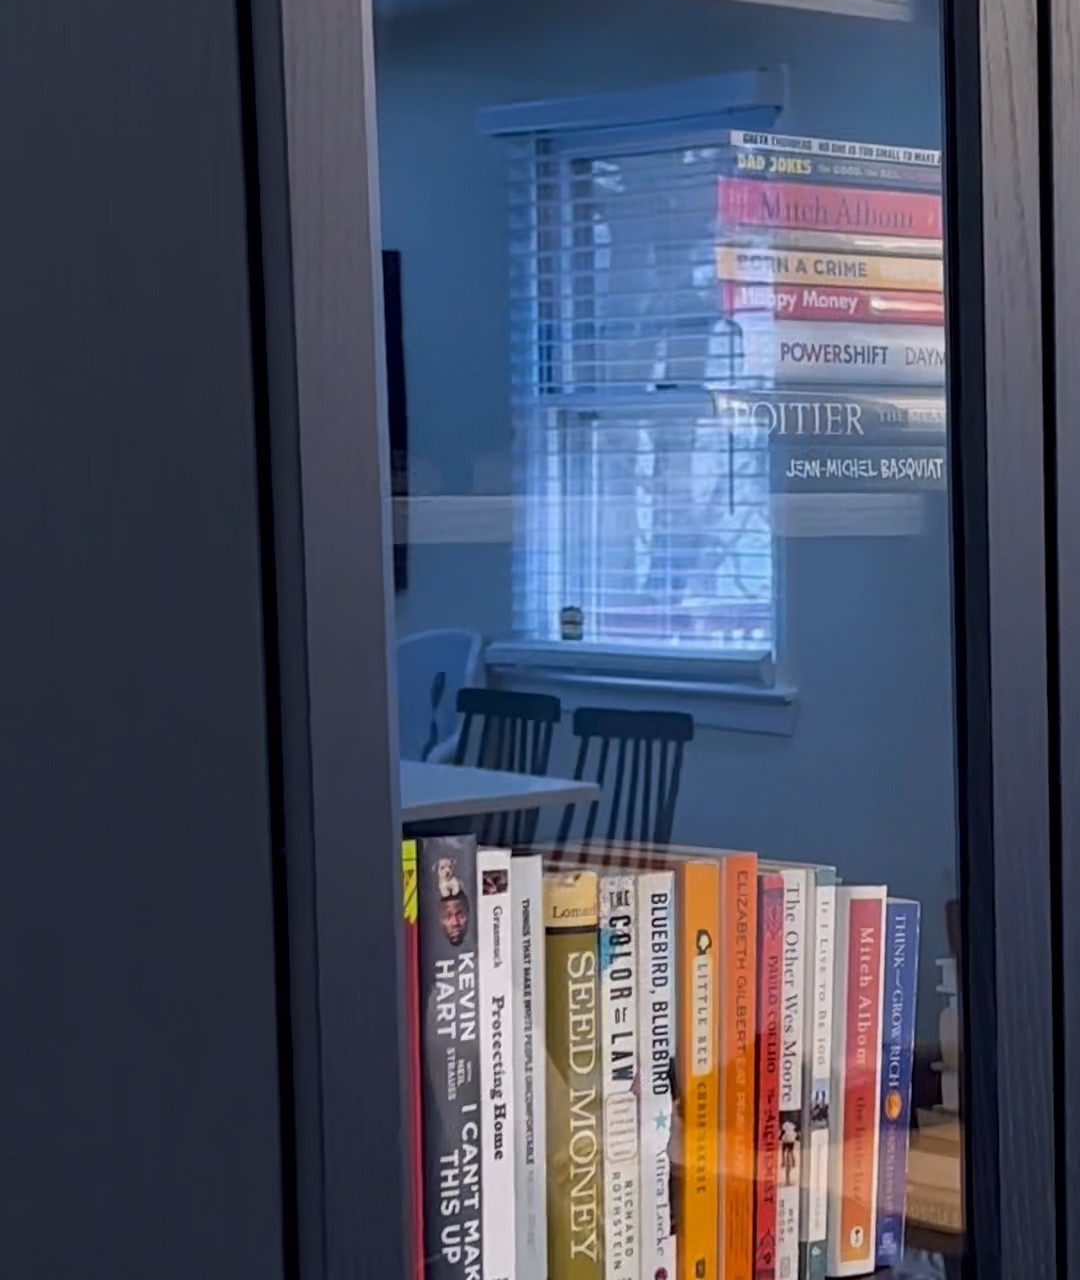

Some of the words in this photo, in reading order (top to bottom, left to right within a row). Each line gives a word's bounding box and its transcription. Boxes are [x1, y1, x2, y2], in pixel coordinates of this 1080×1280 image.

[737, 152, 766, 171] DAD
[768, 155, 812, 175] JOKES
[760, 191, 828, 226] Mitch
[836, 194, 914, 229] Albom
[795, 260, 808, 275] A
[813, 259, 868, 278] CRIME
[803, 290, 859, 314] Money
[780, 342, 889, 366] POWERSHIFT
[733, 400, 865, 437] POITIER
[785, 458, 878, 479] JEAN-MICHEL
[880, 458, 944, 481] BASQUIAT
[608, 890, 630, 908] THE
[735, 870, 749, 968] ELIZABETH
[785, 881, 801, 923] The
[608, 914, 633, 1002] COLOR
[649, 892, 669, 995] BLUEBIRD,
[783, 928, 800, 988] Other
[859, 925, 875, 989] Mitch
[893, 915, 907, 969] THINK
[434, 959, 458, 1041] HART
[457, 951, 477, 1042] KEVIN
[566, 950, 596, 1075] SEED
[696, 962, 708, 1026] LITTLE
[735, 976, 749, 1053] GILBERT
[783, 992, 799, 1033] Wes
[890, 988, 905, 1041] GROW
[490, 995, 508, 1101] Protecting
[610, 1031, 635, 1082] LAW
[651, 1001, 671, 1096] BLUEBIRD
[855, 995, 873, 1067] Albom
[781, 1037, 798, 1104] Moore
[887, 1043, 901, 1088] RICH
[461, 1103, 478, 1114] I
[493, 1103, 508, 1162] Home
[439, 1149, 461, 1218] THIS
[461, 1121, 481, 1211] CAN'T
[569, 1086, 598, 1264] MONEY
[440, 1224, 462, 1265] UP
[611, 1171, 625, 1271] ROTHSTEIN
[623, 1179, 634, 1258] RICHARD
[655, 1202, 668, 1257] Locke
